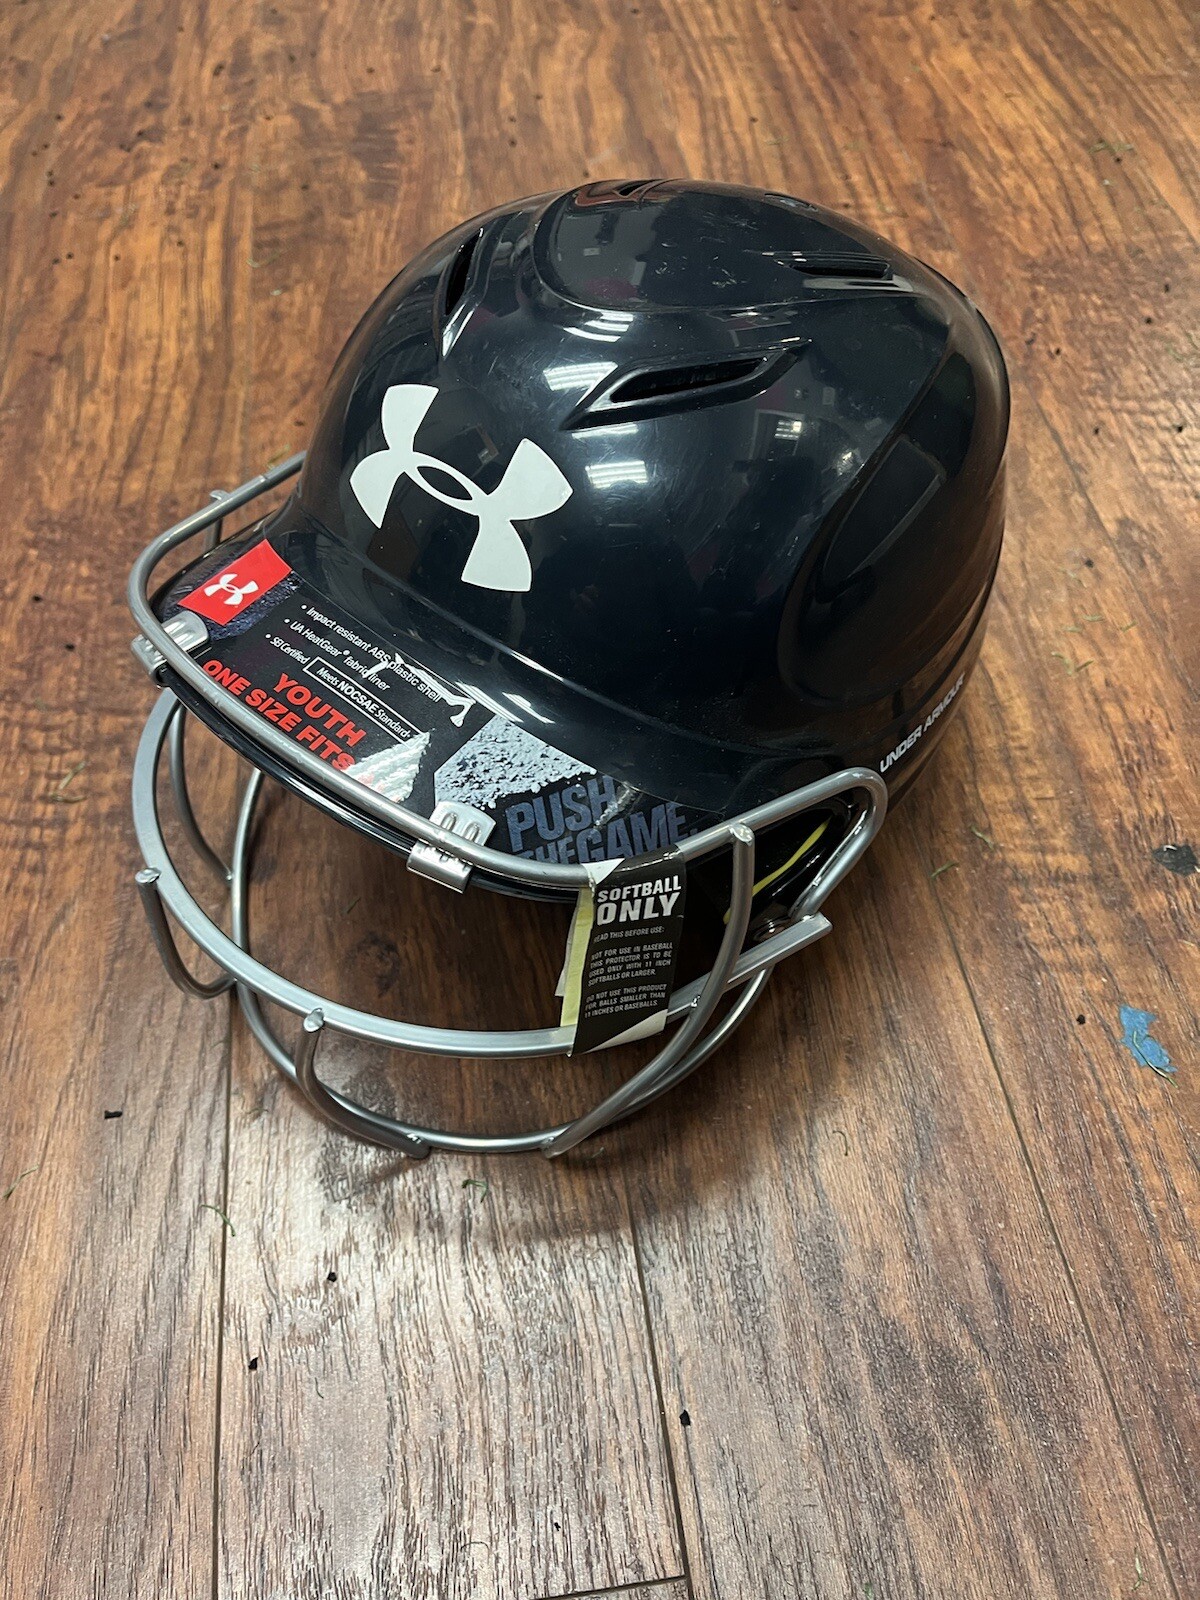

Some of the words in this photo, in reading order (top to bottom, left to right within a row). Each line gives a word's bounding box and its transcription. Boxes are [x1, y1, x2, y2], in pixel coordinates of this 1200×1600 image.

[290, 621, 304, 633] UA
[368, 672, 390, 691] liner
[306, 607, 337, 629] Impact
[333, 625, 373, 652] resistant
[368, 647, 391, 663] ABS
[386, 660, 419, 686] plastic
[417, 683, 443, 702] shell
[280, 643, 310, 664] Certified
[316, 667, 339, 686] Meets
[337, 681, 379, 713] NOCSAE
[202, 660, 251, 695] ONE
[245, 688, 302, 732] SIZE
[296, 725, 356, 771] FITS
[273, 673, 367, 747] YOUTH
[880, 725, 922, 772] UNDER
[923, 672, 965, 732] ARMOUR
[505, 774, 618, 852] PUSH
[597, 875, 682, 903] SOFTBALL
[596, 892, 681, 926] ONLY
[610, 930, 624, 939] THIS
[624, 927, 650, 937] BEFORE
[604, 948, 617, 957] FOR
[618, 946, 632, 954] USE
[633, 945, 641, 953] IN
[642, 942, 673, 951] BASEBALL
[605, 954, 640, 965] PROTECTOR
[653, 951, 661, 959] TO
[663, 949, 672, 957] BE
[588, 967, 605, 978] USED
[607, 964, 623, 973] ONLY
[625, 961, 642, 970] WITH
[645, 960, 652, 968] 11
[655, 958, 671, 967] INCH
[588, 973, 620, 987] SOFTBALLS
[620, 971, 630, 979] OR
[596, 990, 608, 1000] NOT
[609, 988, 621, 997] USE
[623, 986, 637, 995] THIS
[638, 983, 667, 992] PRODUCT
[599, 997, 617, 1006] BALLS
[620, 993, 647, 1003] SMALLER
[649, 991, 666, 999] THAN
[591, 1006, 614, 1016] INCHES
[615, 1004, 624, 1012] OR
